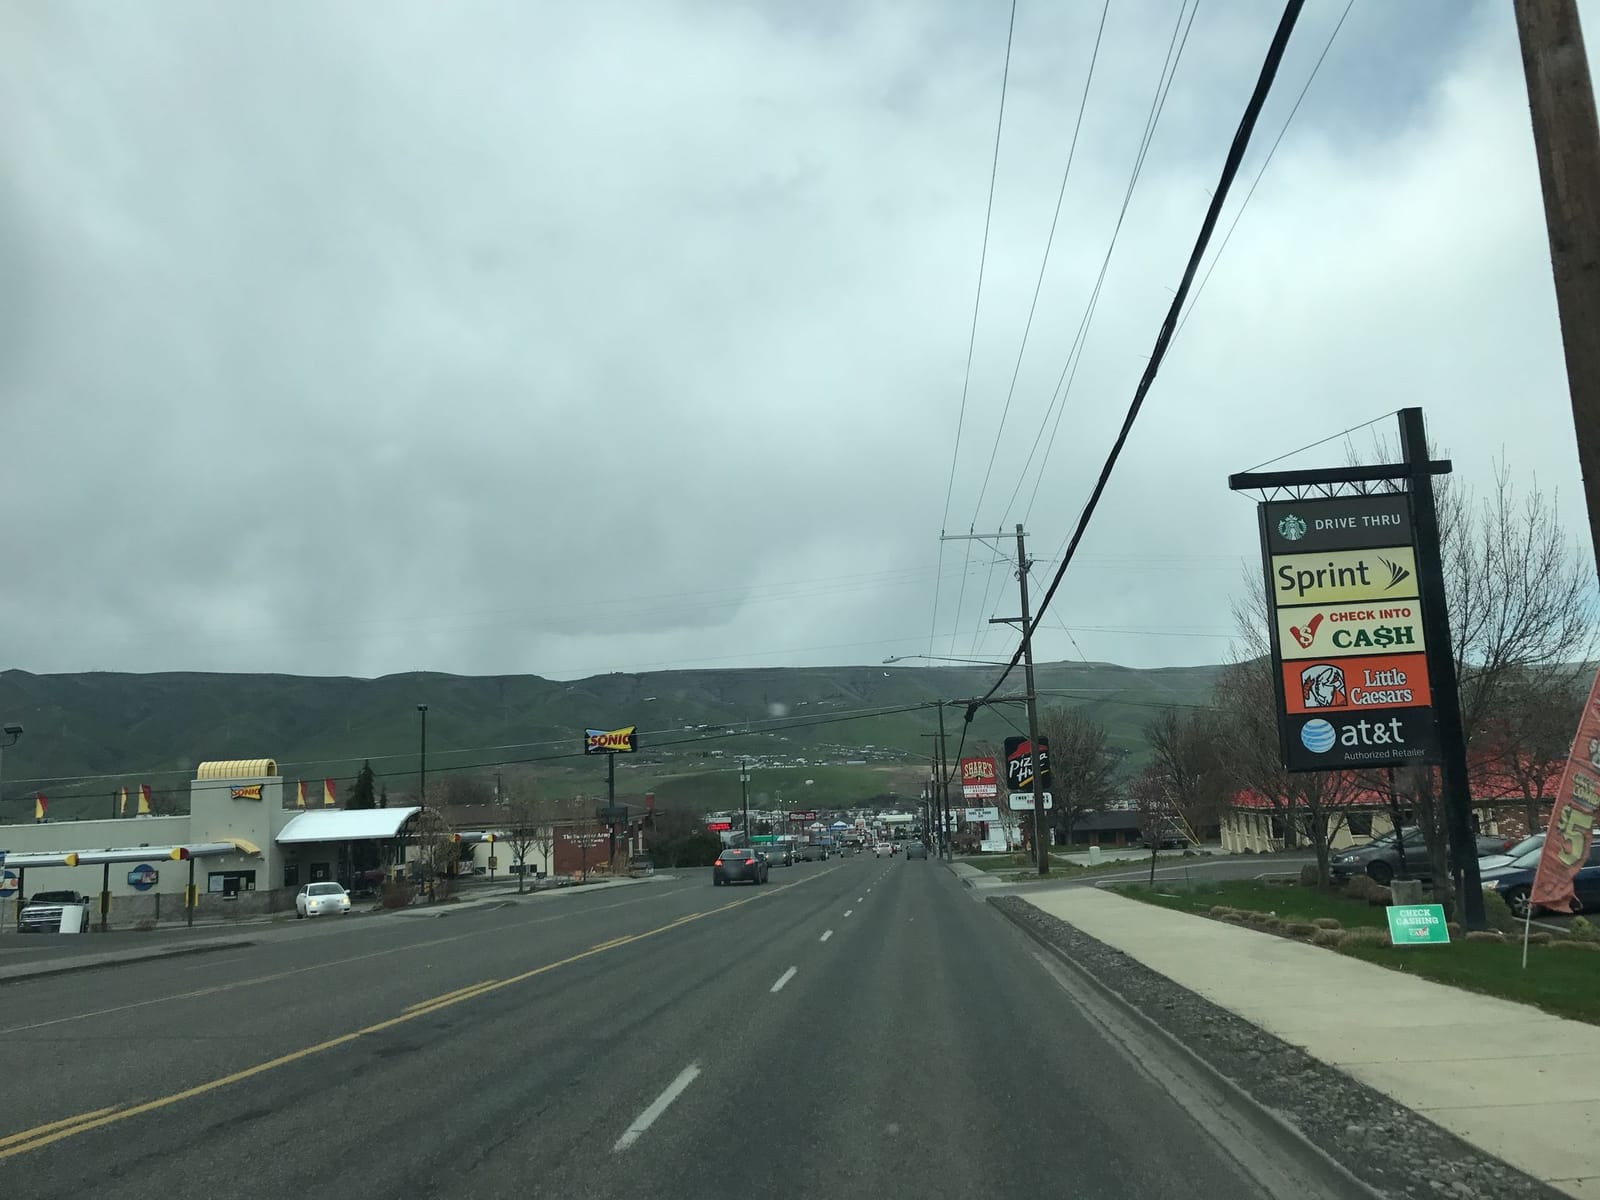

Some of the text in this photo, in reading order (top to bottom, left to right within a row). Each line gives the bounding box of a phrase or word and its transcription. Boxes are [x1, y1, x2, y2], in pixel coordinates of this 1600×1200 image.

[1315, 514, 1401, 531] DRIVE THRU
[1278, 560, 1371, 597] Sprint
[1330, 608, 1411, 623] CHECK INTO
[1364, 668, 1408, 687] Little
[1350, 686, 1413, 706] Caesars
[591, 733, 631, 747] SONIC
[1340, 717, 1405, 747] at&t
[1344, 747, 1426, 761] Authorized Retailer
[964, 761, 994, 777] SHARP'S
[1009, 752, 1048, 779] Piza
[1396, 917, 1439, 925] CASHING
[1399, 909, 1431, 917] CHECK
